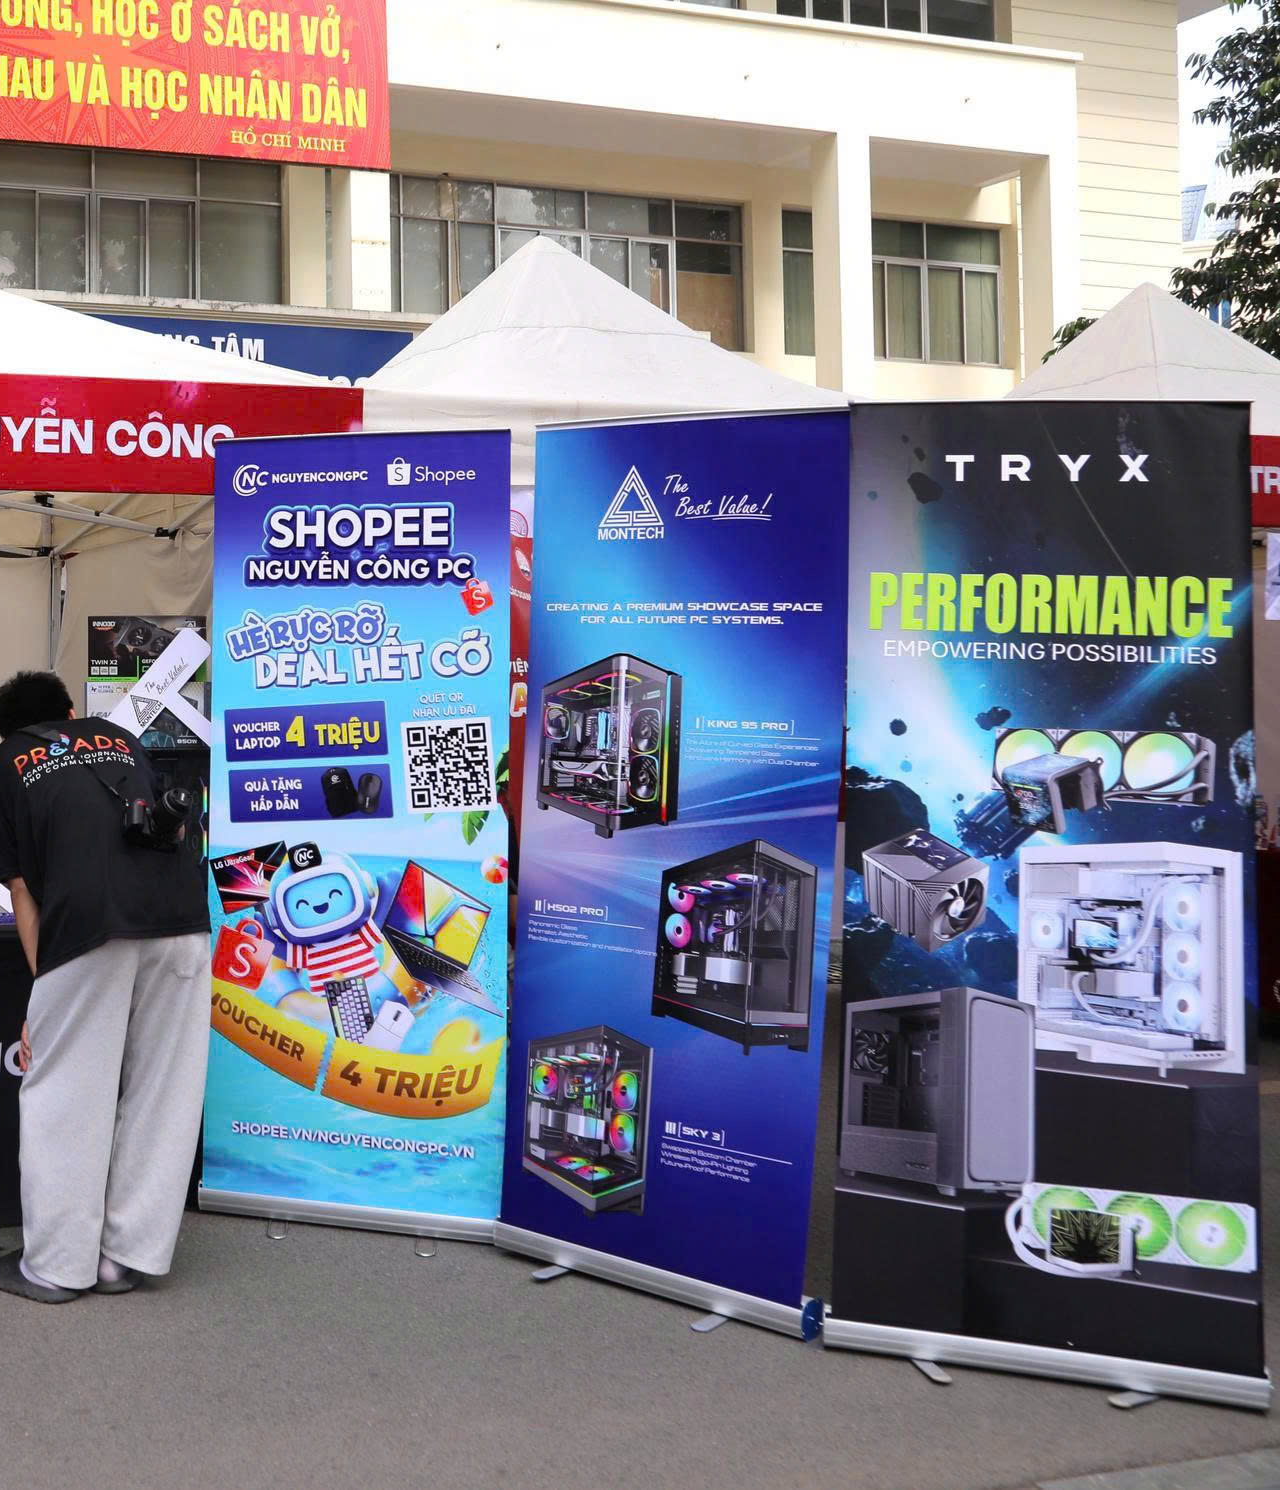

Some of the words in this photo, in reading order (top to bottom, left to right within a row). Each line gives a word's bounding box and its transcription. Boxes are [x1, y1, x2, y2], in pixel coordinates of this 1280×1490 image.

[203, 0, 290, 53] SÁCH
[300, 5, 350, 64] VỞ,
[65, 54, 110, 105] VÀ
[120, 66, 188, 119] HỌC
[199, 69, 291, 121] NHÂN
[302, 77, 368, 128] DÂN
[231, 126, 257, 145] HỒ
[261, 131, 291, 148] CHÍ
[298, 136, 346, 152] MINH
[211, 333, 265, 361] TÂM
[272, 470, 369, 484] NGUYENCONGPC
[415, 466, 476, 486] Shopee
[663, 474, 689, 495] The
[675, 497, 711, 517] Best
[718, 493, 773, 516] Value!
[269, 507, 450, 549] SHOPEE
[598, 526, 664, 541] MONTECH
[249, 551, 350, 580] NGUYỄN
[356, 555, 430, 580] CÔNG
[437, 558, 471, 580] PC
[546, 603, 608, 611] CREATING
[613, 603, 622, 611] A
[627, 603, 683, 611] PREMIUM
[688, 603, 769, 612] SHOWCASE
[773, 603, 823, 612] SPACE
[868, 572, 1233, 638] PERFORMANCE
[580, 616, 606, 624] FOR
[610, 616, 634, 624] ALL
[637, 616, 687, 625] FUTURE
[690, 616, 708, 625] PC
[712, 616, 784, 625] SYSTEMS.
[230, 613, 266, 657] HÈ
[256, 649, 347, 688] DEAL
[354, 627, 423, 683] HẾT
[883, 639, 1045, 660] EMPOWERING
[1052, 644, 1217, 665] POSSIBILITIES
[448, 692, 464, 703] QR
[139, 702, 163, 728] MONTECH
[707, 720, 738, 729] KING
[761, 722, 789, 731] PRO
[233, 721, 280, 734] VOUCHER
[286, 715, 306, 747] 4
[315, 717, 381, 750] TRIỆU
[235, 737, 281, 750] LAPTOP
[22, 758, 60, 783] ACADEMY
[46, 757, 135, 773] COMMUNICATION
[244, 777, 269, 793] QUÀ
[271, 777, 302, 794] TẶNG
[250, 795, 273, 813] HẤP
[275, 792, 299, 812] DẪN
[214, 861, 223, 869] LG
[580, 906, 604, 916] PRO
[211, 992, 305, 1062] VOUCHER
[340, 1060, 363, 1087] 4
[374, 1063, 482, 1107] TRIỆU
[231, 1120, 475, 1159] SHOPEE.VN/NGUYENCONGPC.VN
[682, 1126, 708, 1139] SKY
